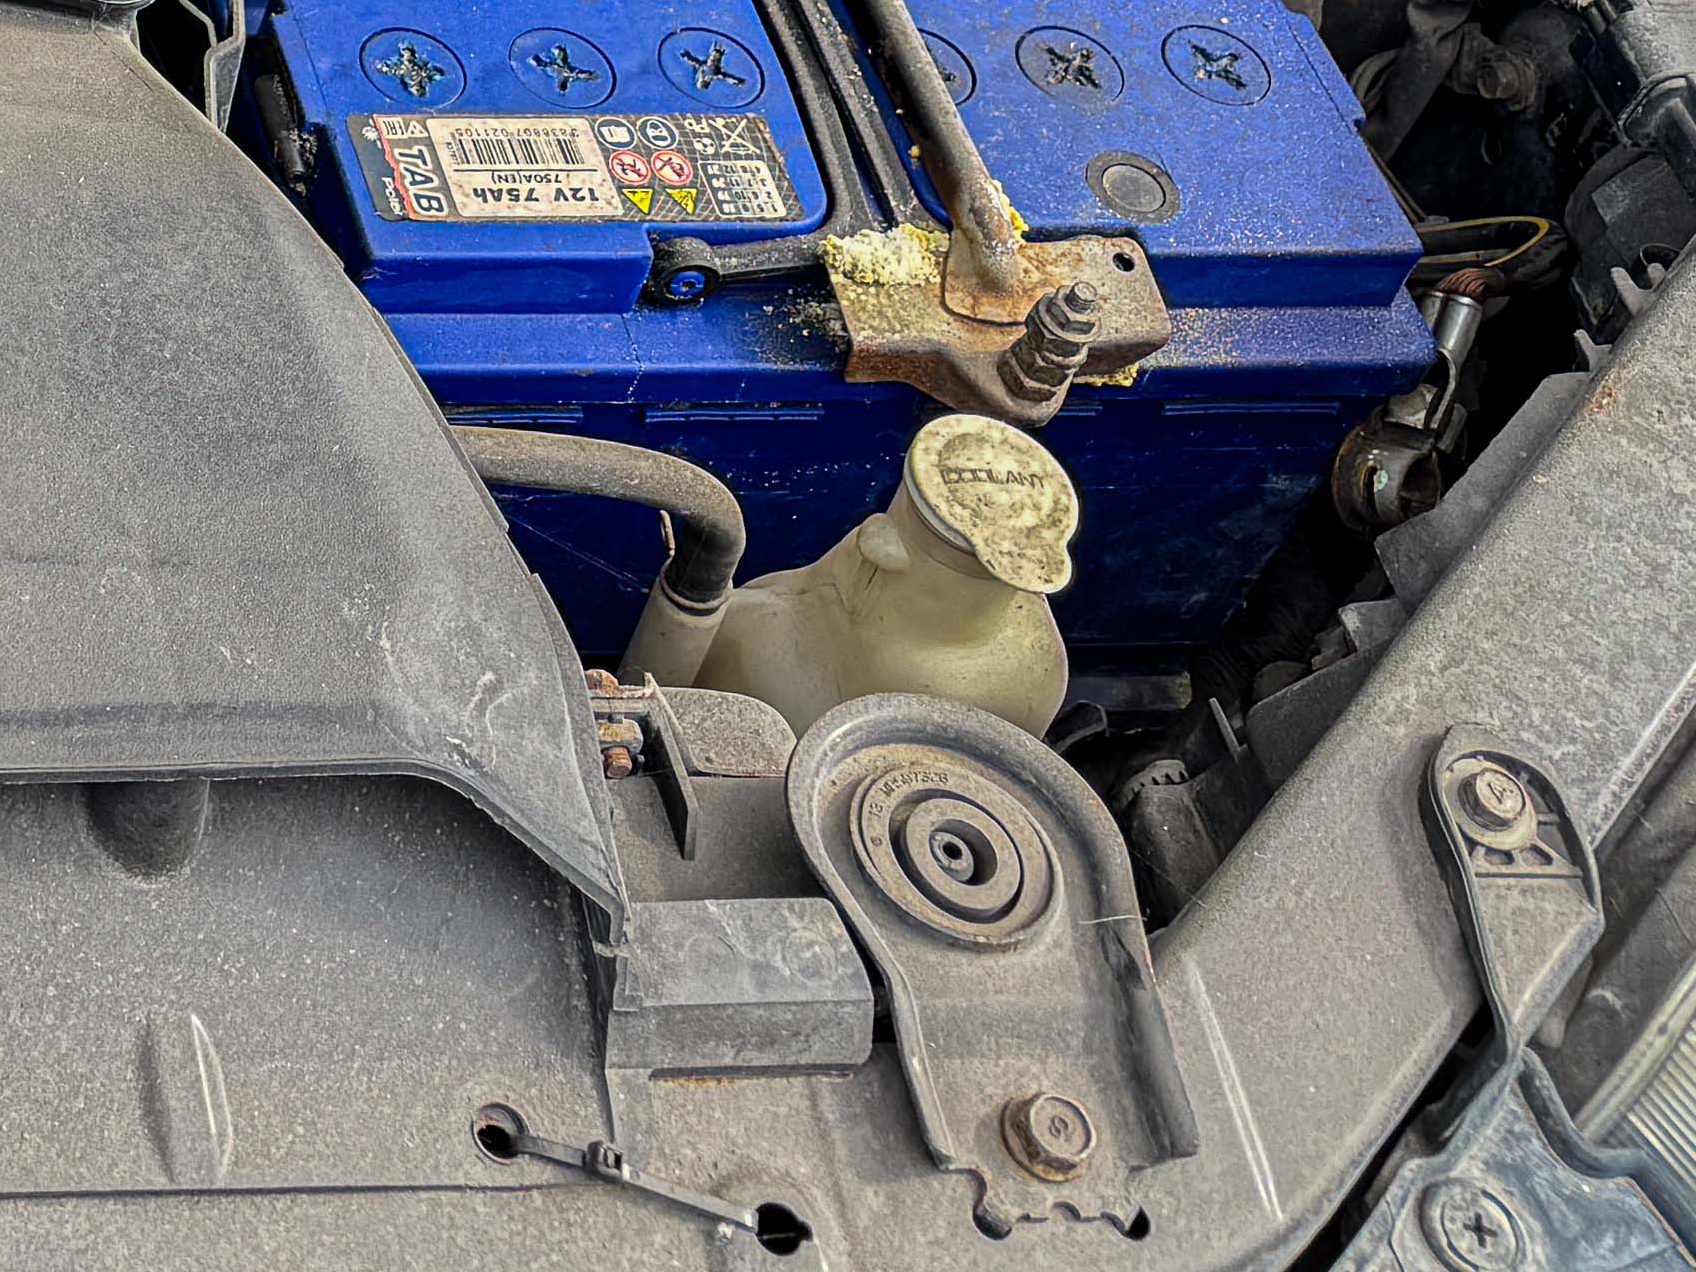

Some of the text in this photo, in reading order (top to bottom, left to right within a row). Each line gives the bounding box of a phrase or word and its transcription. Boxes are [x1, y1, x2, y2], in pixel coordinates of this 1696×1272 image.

[395, 147, 445, 214] TAB
[471, 187, 600, 204] 12V 75Ah
